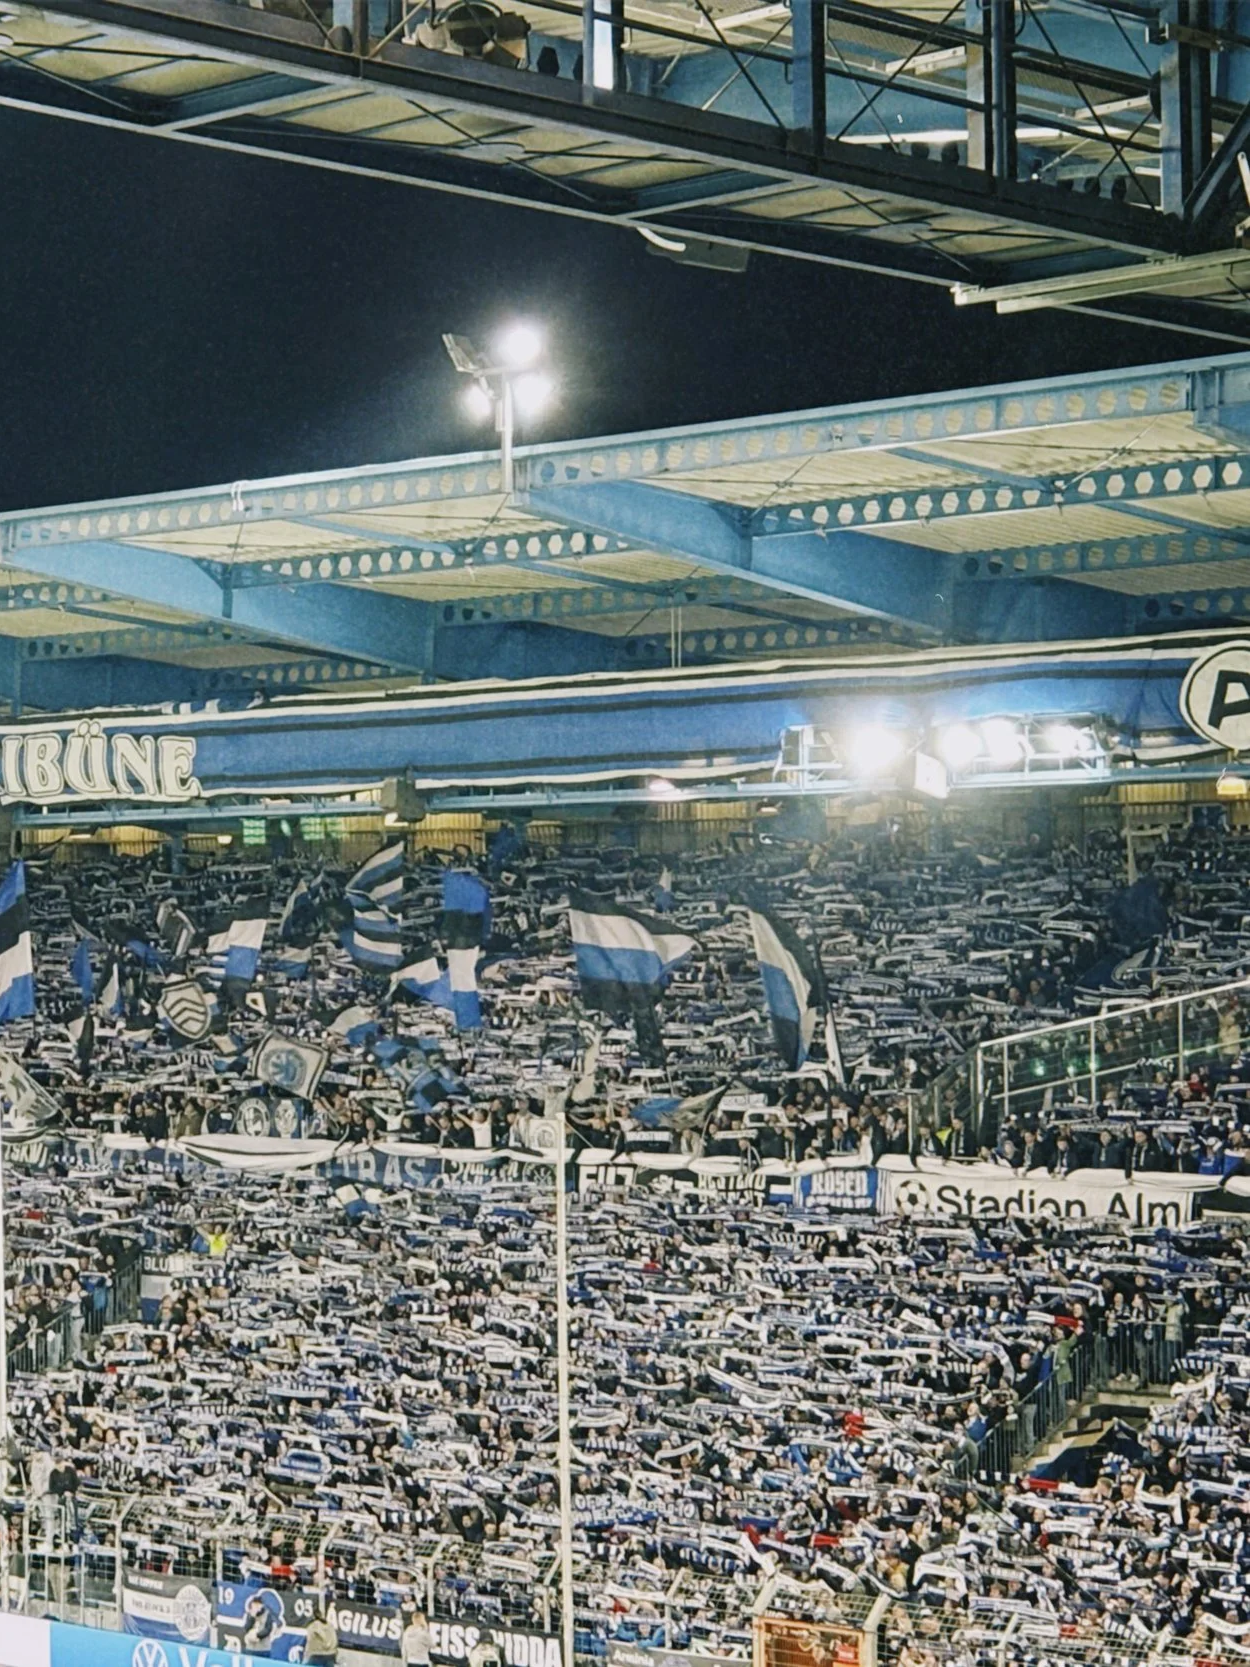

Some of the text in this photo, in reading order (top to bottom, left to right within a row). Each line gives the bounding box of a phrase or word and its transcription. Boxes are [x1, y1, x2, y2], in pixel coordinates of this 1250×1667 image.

[1107, 1190, 1182, 1229] Alm
[217, 1586, 235, 1605] 19
[294, 1598, 314, 1618] 05
